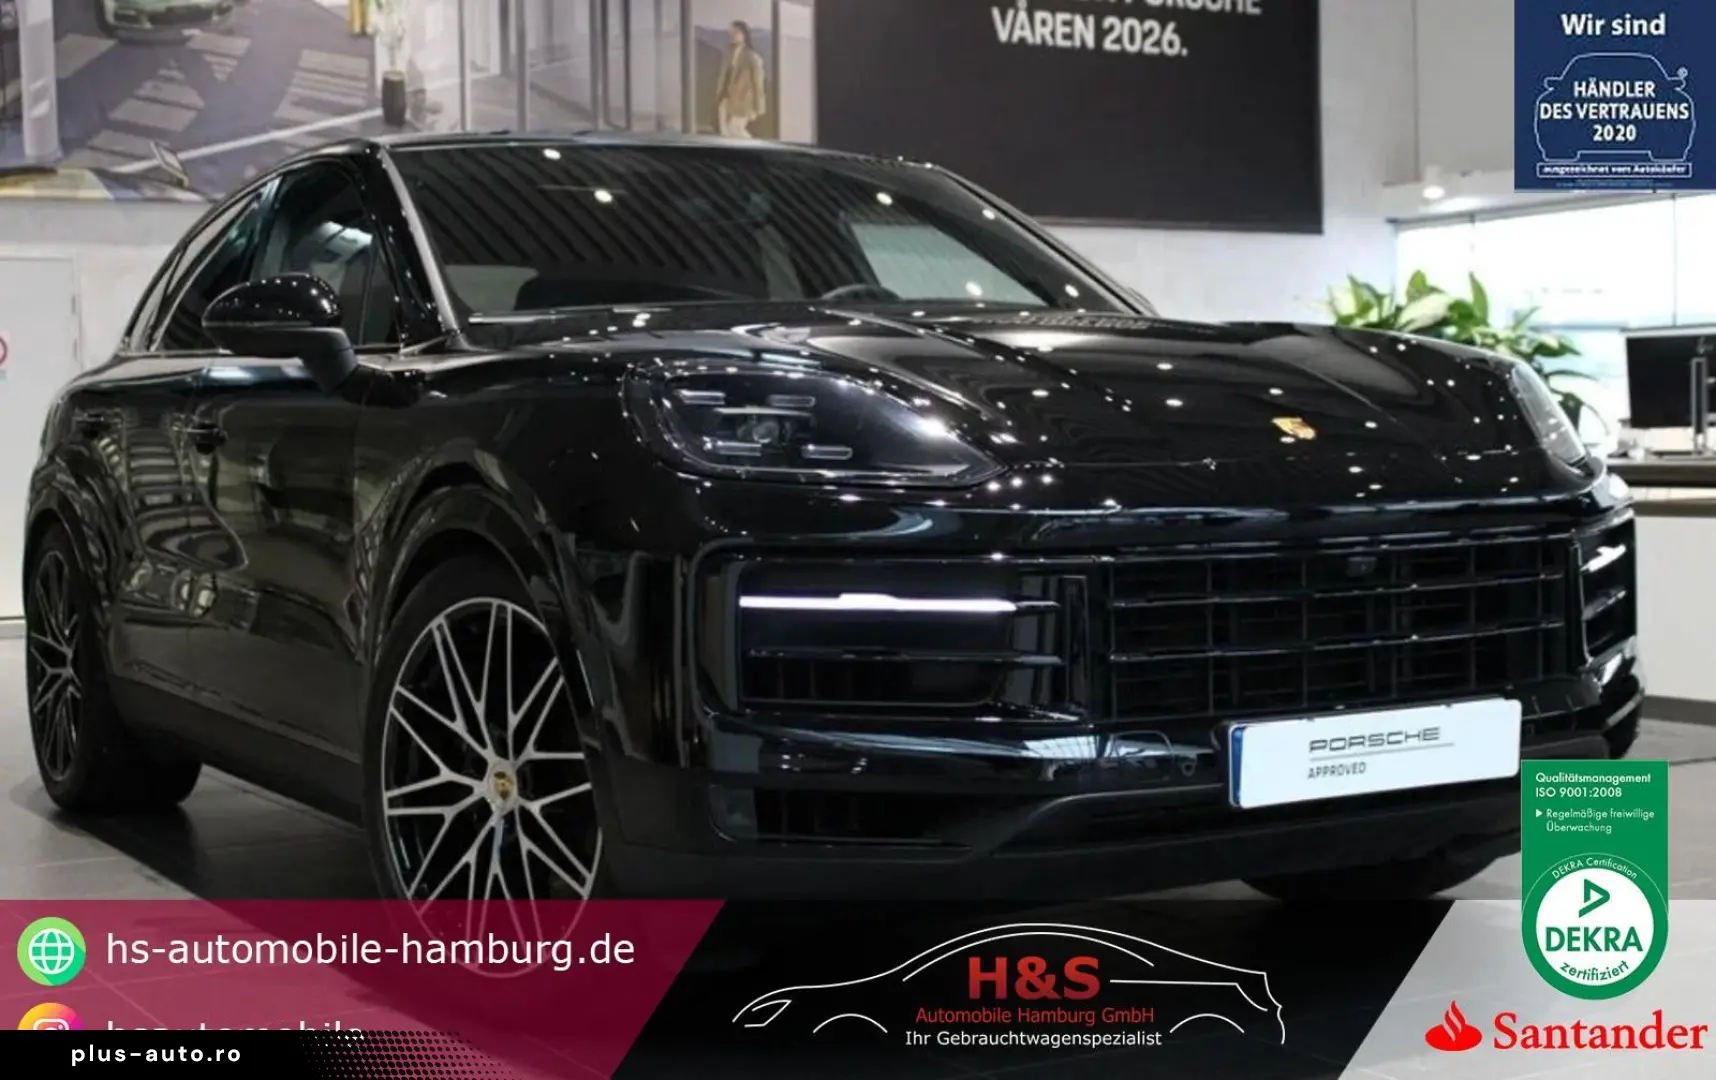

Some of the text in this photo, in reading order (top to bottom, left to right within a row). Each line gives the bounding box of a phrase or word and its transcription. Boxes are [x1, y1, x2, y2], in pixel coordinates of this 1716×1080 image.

[991, 0, 1188, 56] VÅREN 2026.
[1309, 727, 1441, 753] PORSCHE
[1307, 762, 1367, 780] APPROVED
